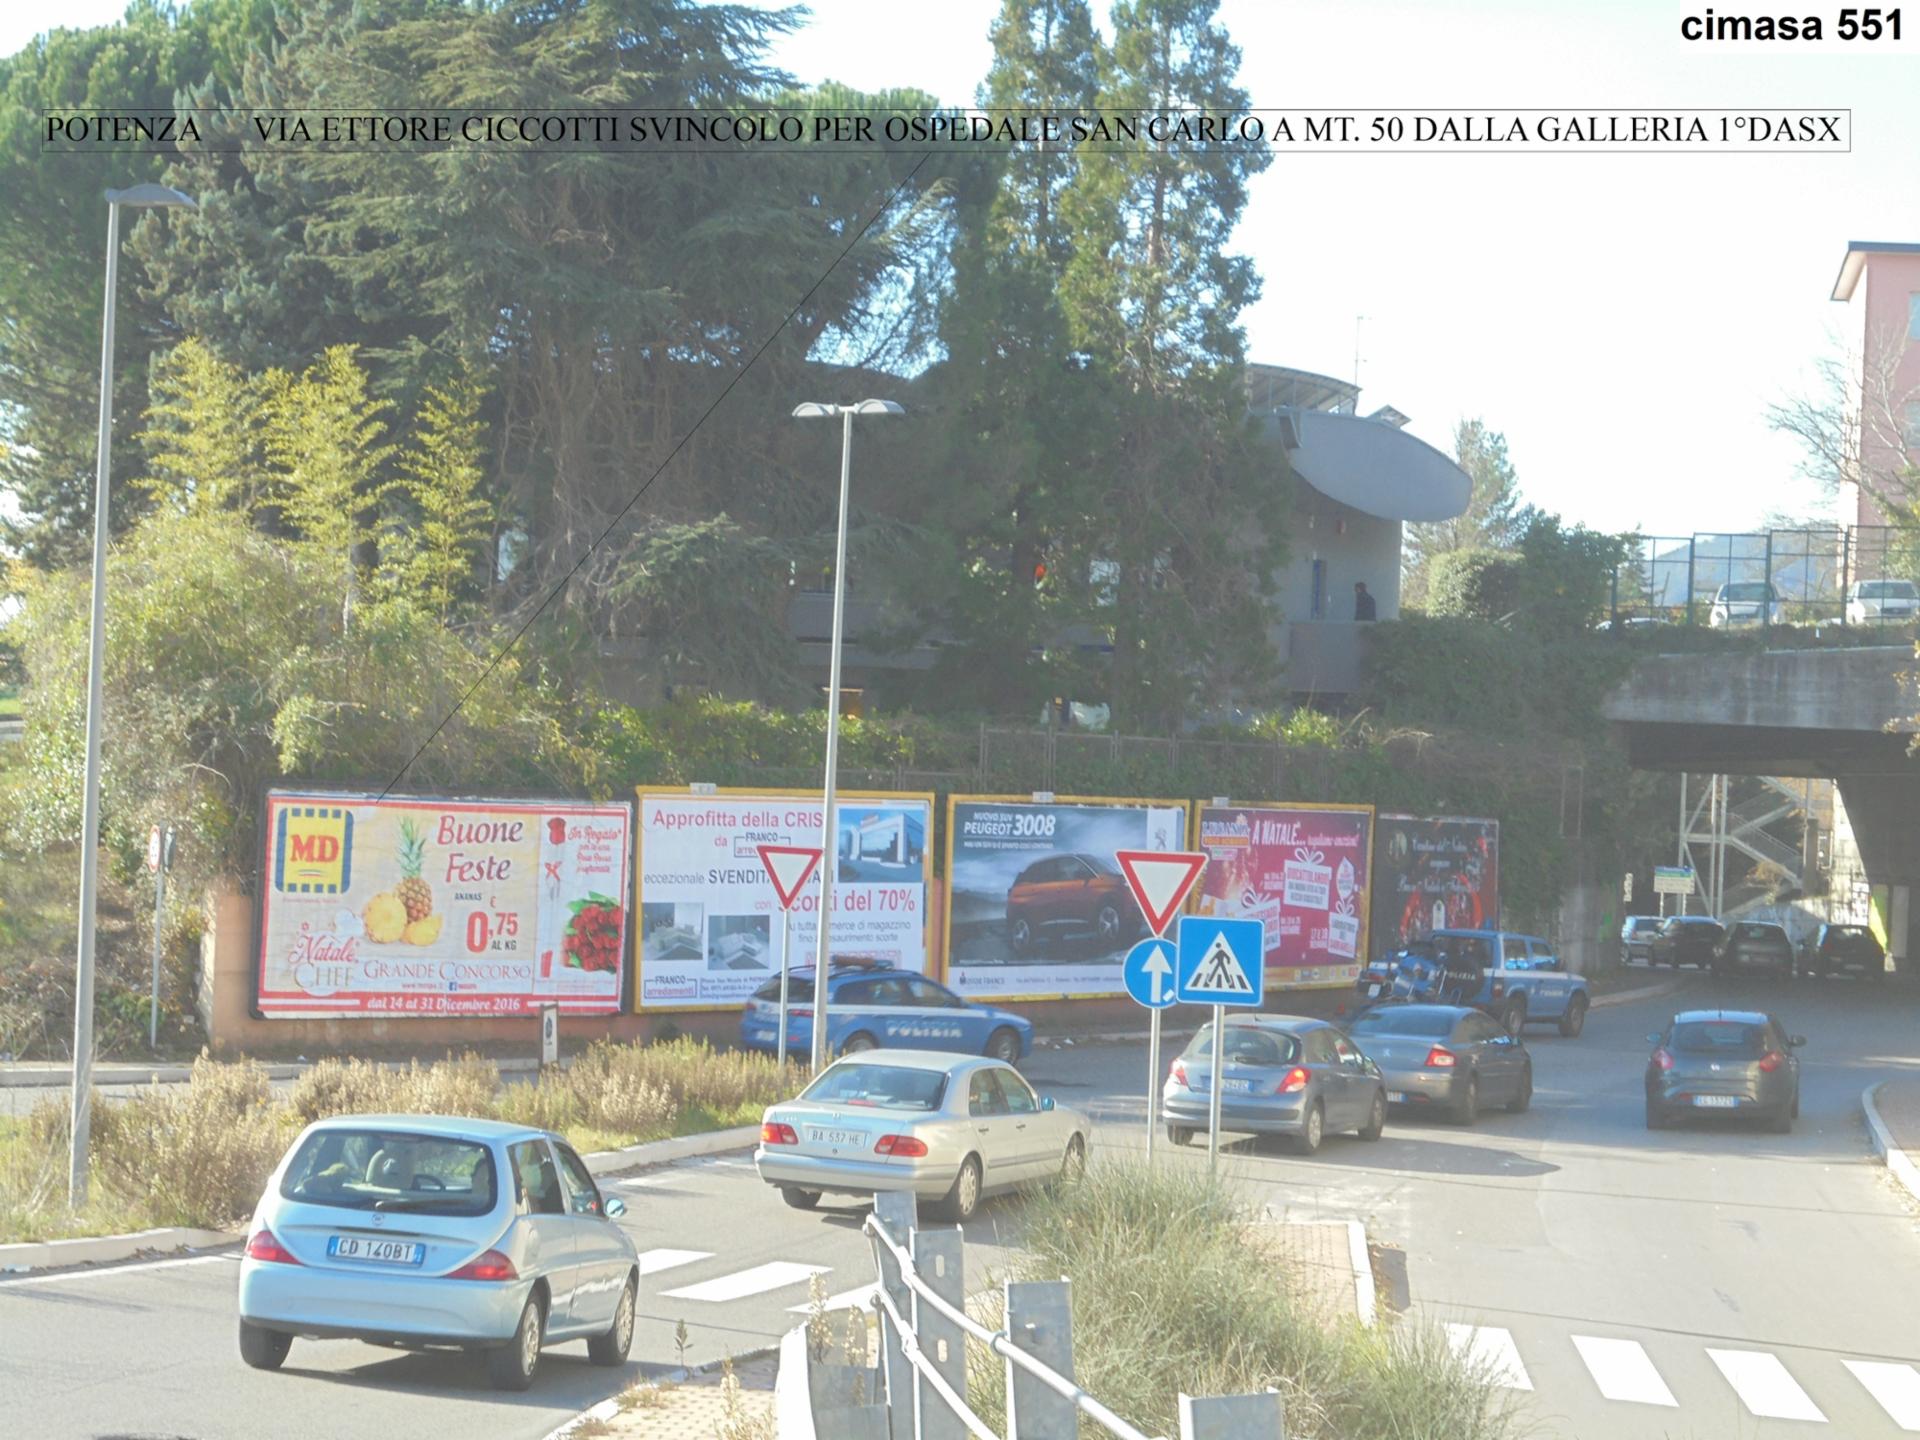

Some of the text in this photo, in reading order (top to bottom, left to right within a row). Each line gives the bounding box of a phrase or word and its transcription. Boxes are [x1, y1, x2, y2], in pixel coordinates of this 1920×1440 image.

[437, 814, 523, 845] Buone
[652, 809, 823, 830] Approfitta della CRIS
[963, 814, 1057, 836] PEUGEOT 3008
[714, 836, 728, 848] da
[745, 832, 779, 843] FRANCO
[290, 834, 340, 864] MD
[446, 853, 511, 883] Feste
[644, 868, 769, 885] eccezionale SVENDIT
[454, 891, 483, 902] ANANAS
[754, 900, 772, 911] con
[844, 889, 872, 911] del
[878, 888, 915, 912] 70%
[467, 911, 518, 953] 0,75
[491, 940, 517, 951] AL KG
[363, 959, 532, 981] GRANDE CONCORSO
[655, 976, 686, 985] FRANCO
[420, 998, 434, 1010] 31
[436, 998, 491, 1011] Dicembre
[494, 998, 521, 1011] 2016
[339, 1239, 413, 1260] CD 140BT
